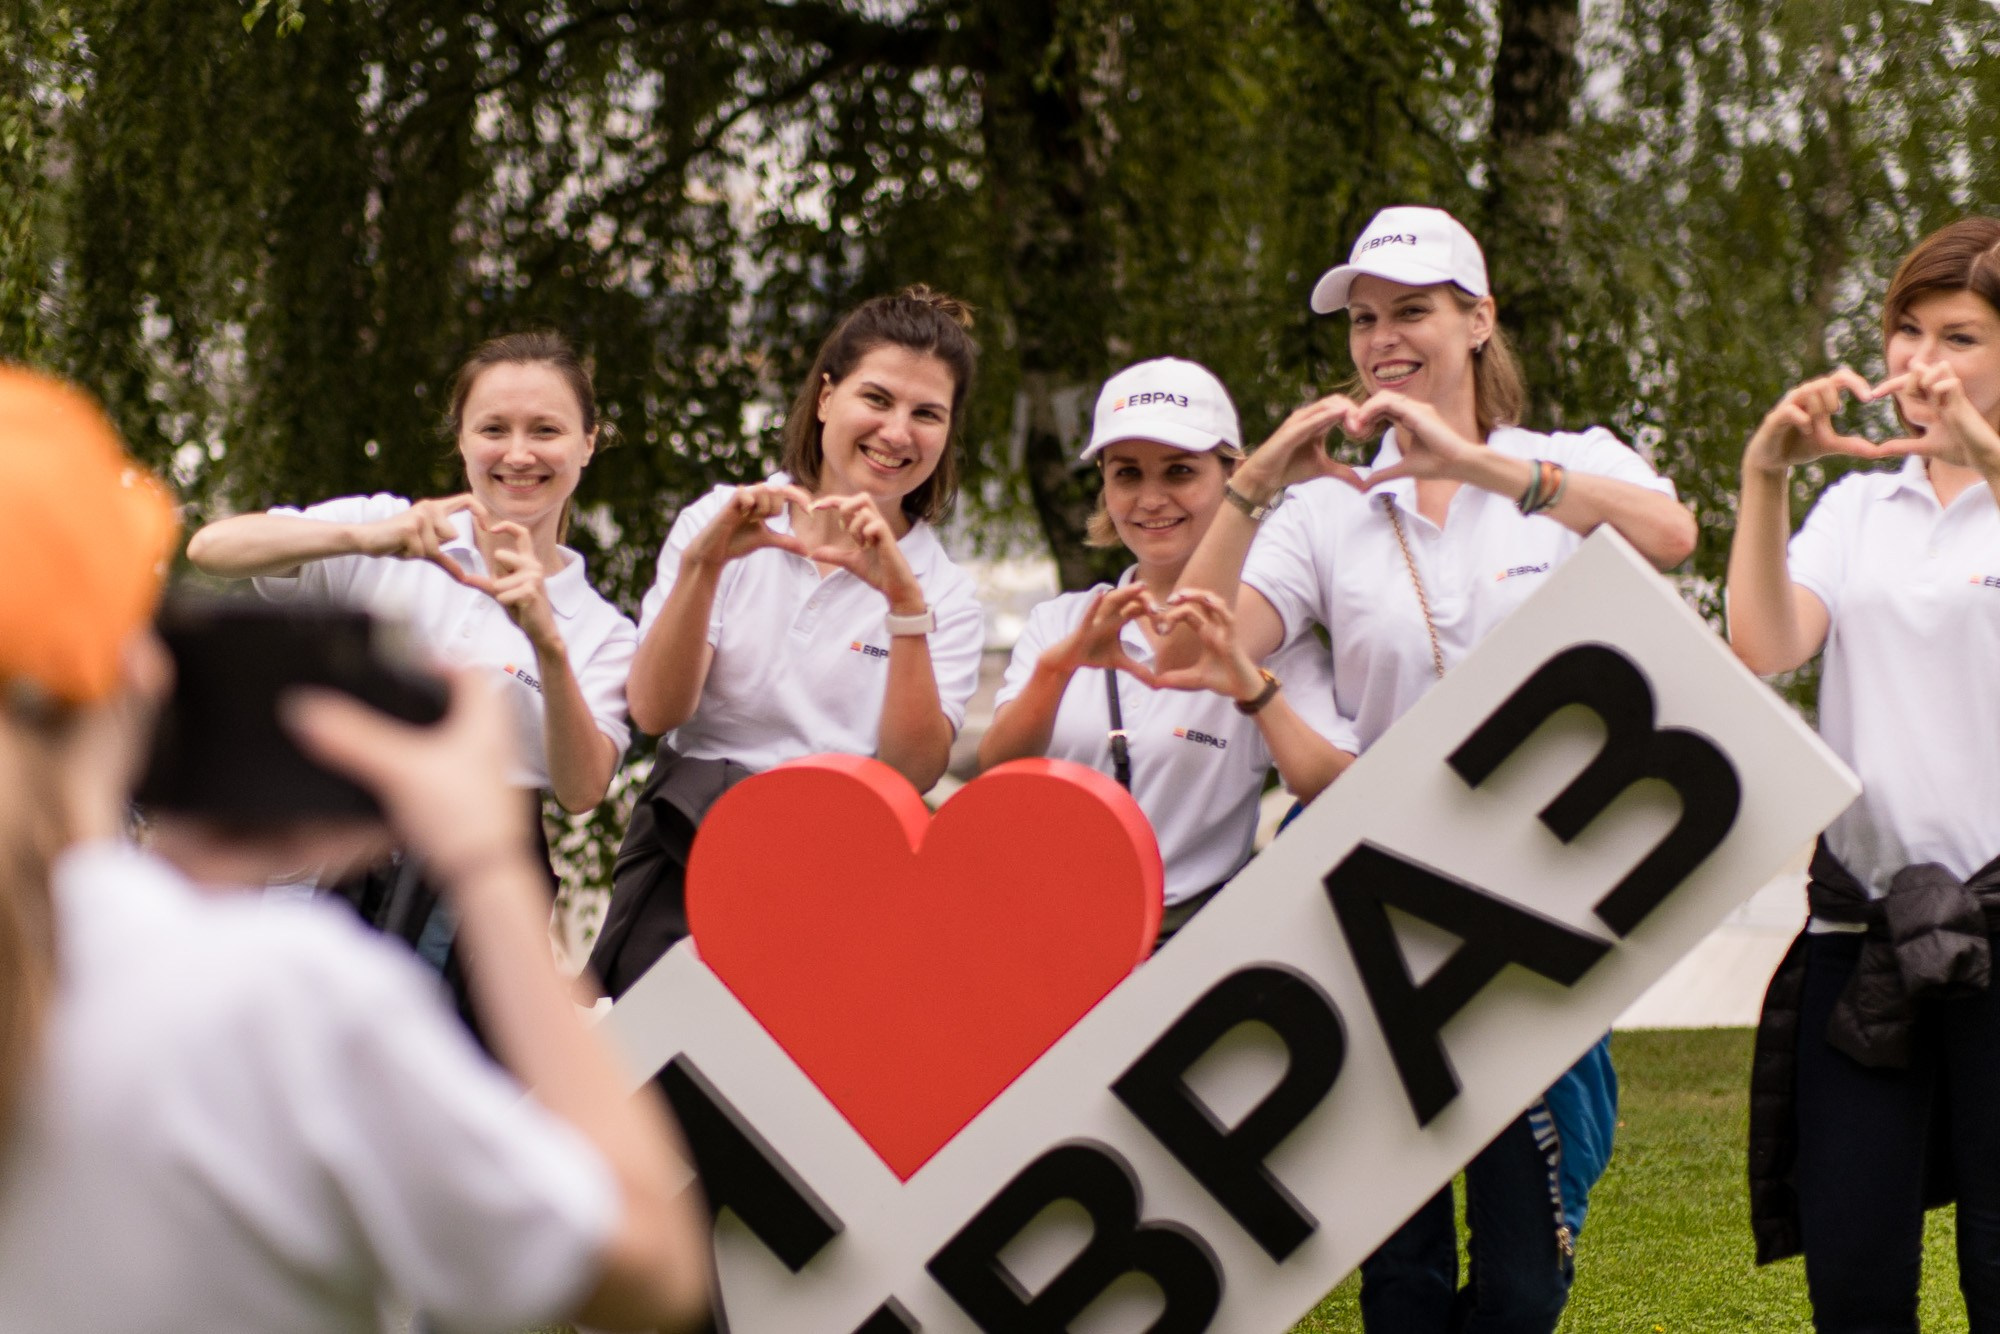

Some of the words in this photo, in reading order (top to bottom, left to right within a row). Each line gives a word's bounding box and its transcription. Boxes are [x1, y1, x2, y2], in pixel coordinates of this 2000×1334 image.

[1361, 234, 1417, 253] ЕВРАЗ
[1128, 392, 1189, 407] ЕВРАЗ
[1507, 562, 1548, 577] ЕВРАЗ
[863, 644, 889, 658] ЕВР
[1186, 729, 1227, 749] ЕВРАЗ
[851, 641, 1743, 1334] ВРАЗ
